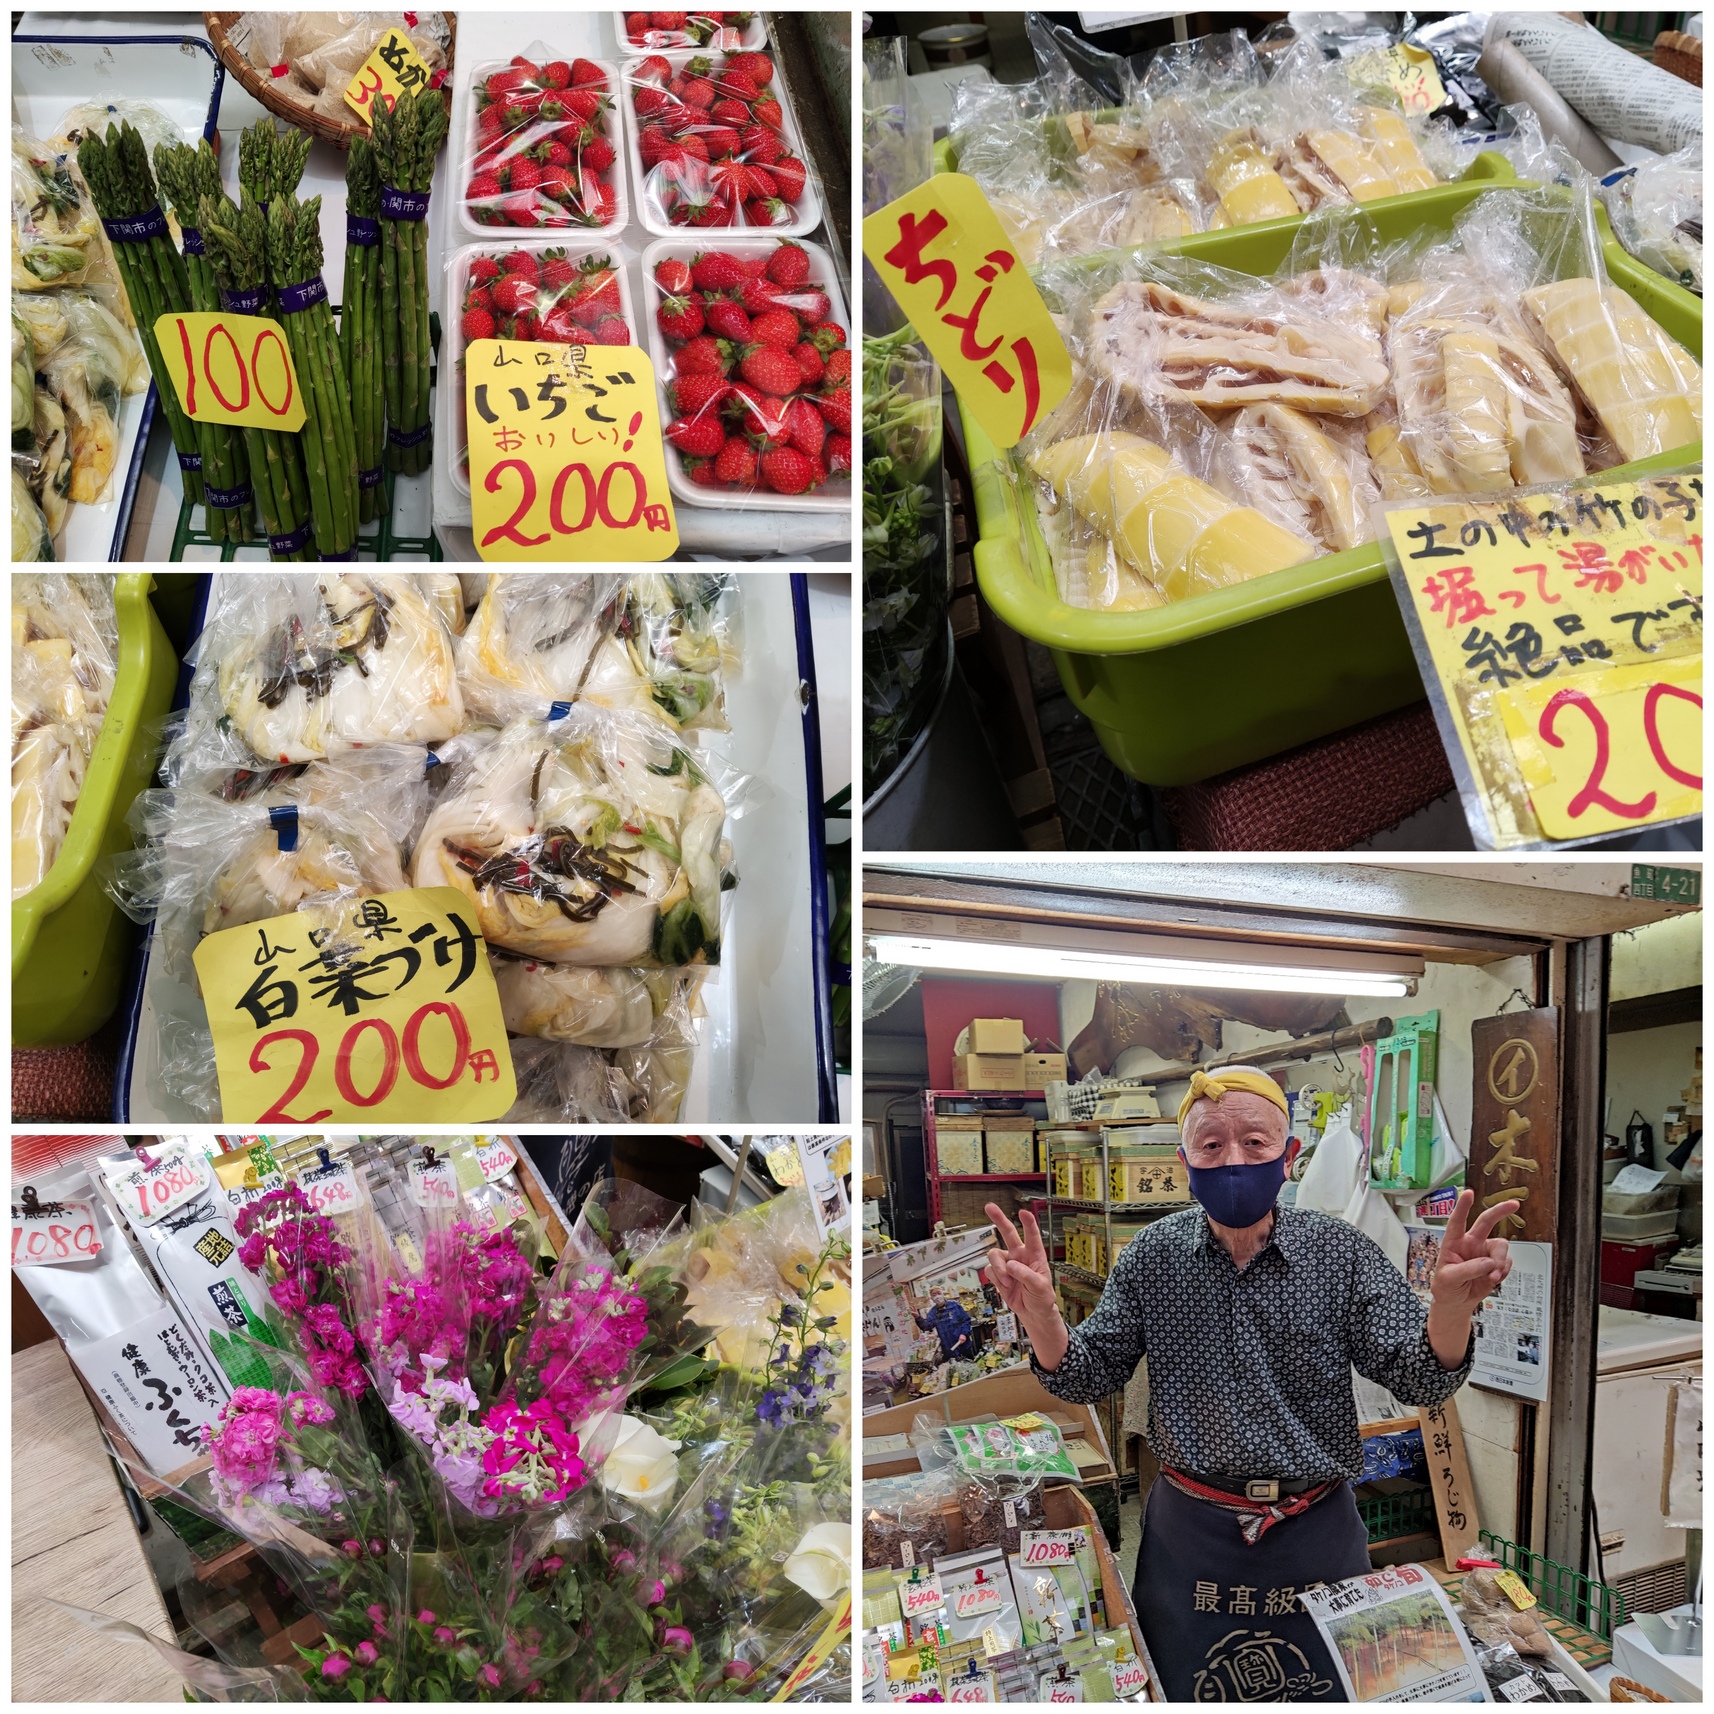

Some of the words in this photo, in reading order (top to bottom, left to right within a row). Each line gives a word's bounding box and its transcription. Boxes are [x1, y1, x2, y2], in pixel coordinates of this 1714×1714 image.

[884, 209, 1040, 439] ちどり
[176, 318, 292, 415] 100
[493, 344, 594, 379] 山口県
[475, 372, 636, 424] いちご
[481, 459, 671, 547] 200円
[1662, 875, 1696, 896] 4-21
[254, 900, 402, 966] 山口県
[248, 1001, 499, 1123] 200円
[212, 1284, 244, 1325] 煎茶
[907, 1590, 940, 1611] 540円
[1115, 1670, 1146, 1691] 540円
